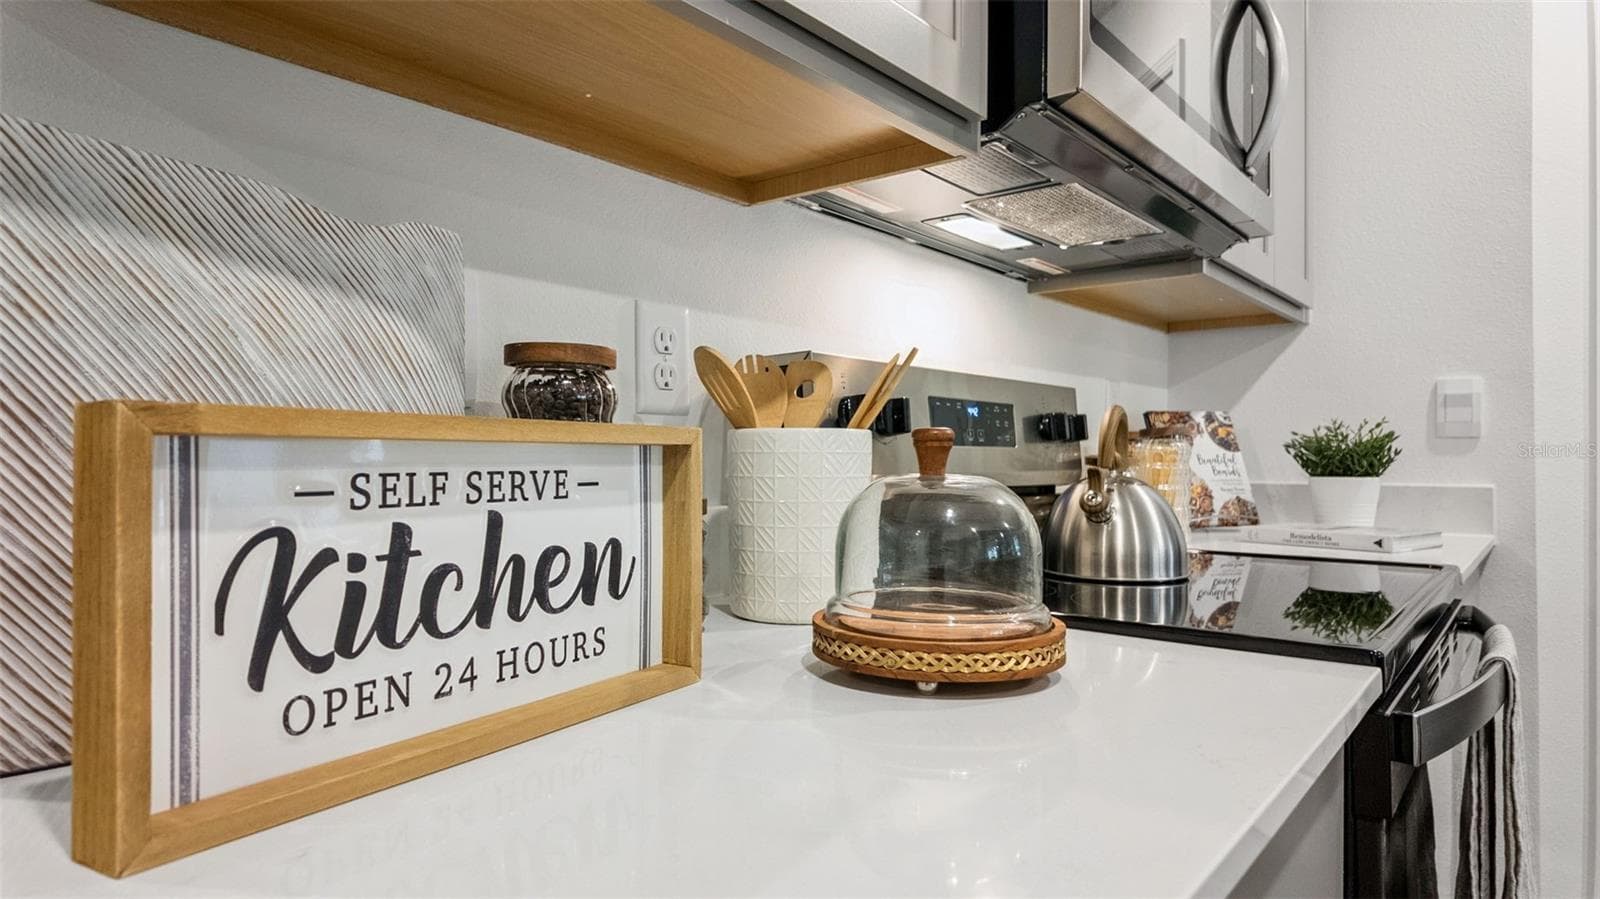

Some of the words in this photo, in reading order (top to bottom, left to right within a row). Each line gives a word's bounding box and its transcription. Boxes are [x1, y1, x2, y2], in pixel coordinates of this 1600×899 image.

[349, 471, 449, 511] SELF
[465, 469, 569, 505] SERVE
[214, 509, 636, 693] Kitchen
[282, 671, 413, 737] OPEN
[433, 656, 478, 700] 24
[496, 626, 606, 683] HOURS
